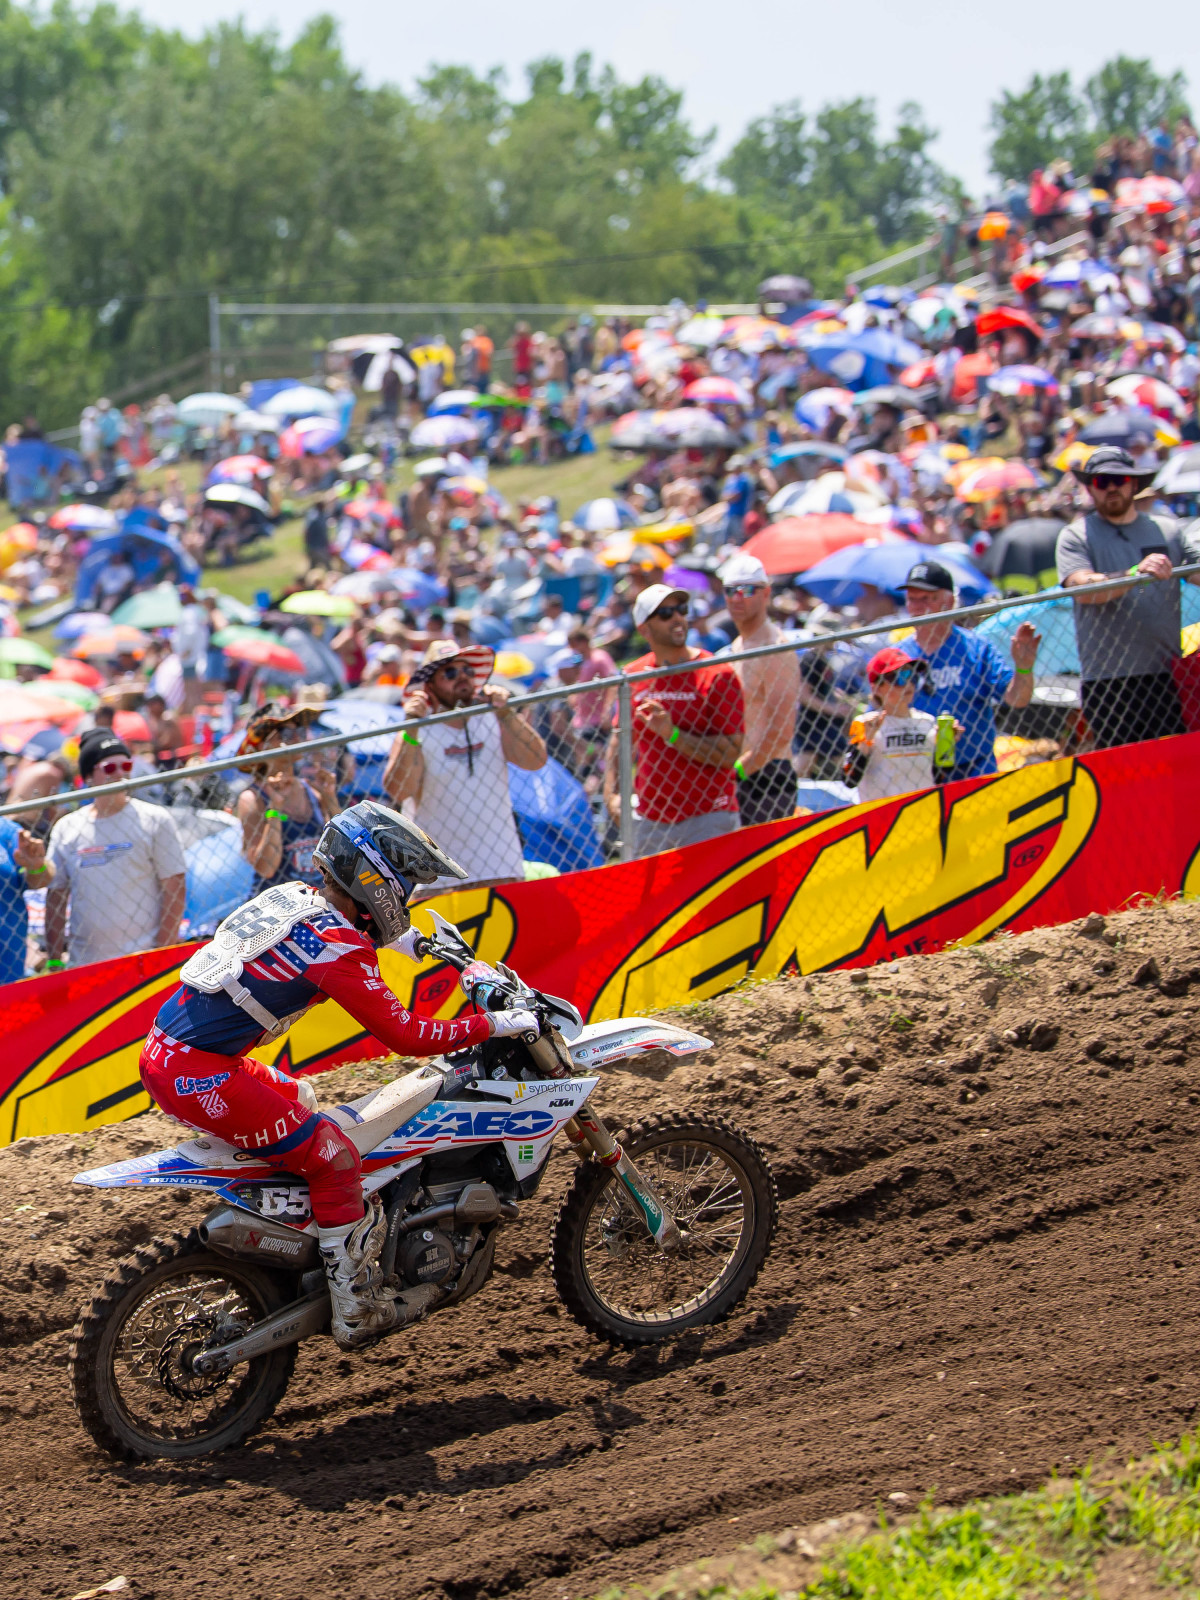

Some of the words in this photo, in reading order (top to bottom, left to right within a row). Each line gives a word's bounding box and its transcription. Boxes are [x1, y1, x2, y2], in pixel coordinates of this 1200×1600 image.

[886, 733, 927, 748] MSR
[224, 905, 281, 940] 65
[175, 1072, 231, 1096] USA
[529, 1082, 583, 1094] synchrony
[548, 1099, 574, 1108] KTM
[415, 1110, 554, 1137] AEO
[148, 1176, 208, 1185] DUNLOP
[257, 1186, 312, 1218] 65
